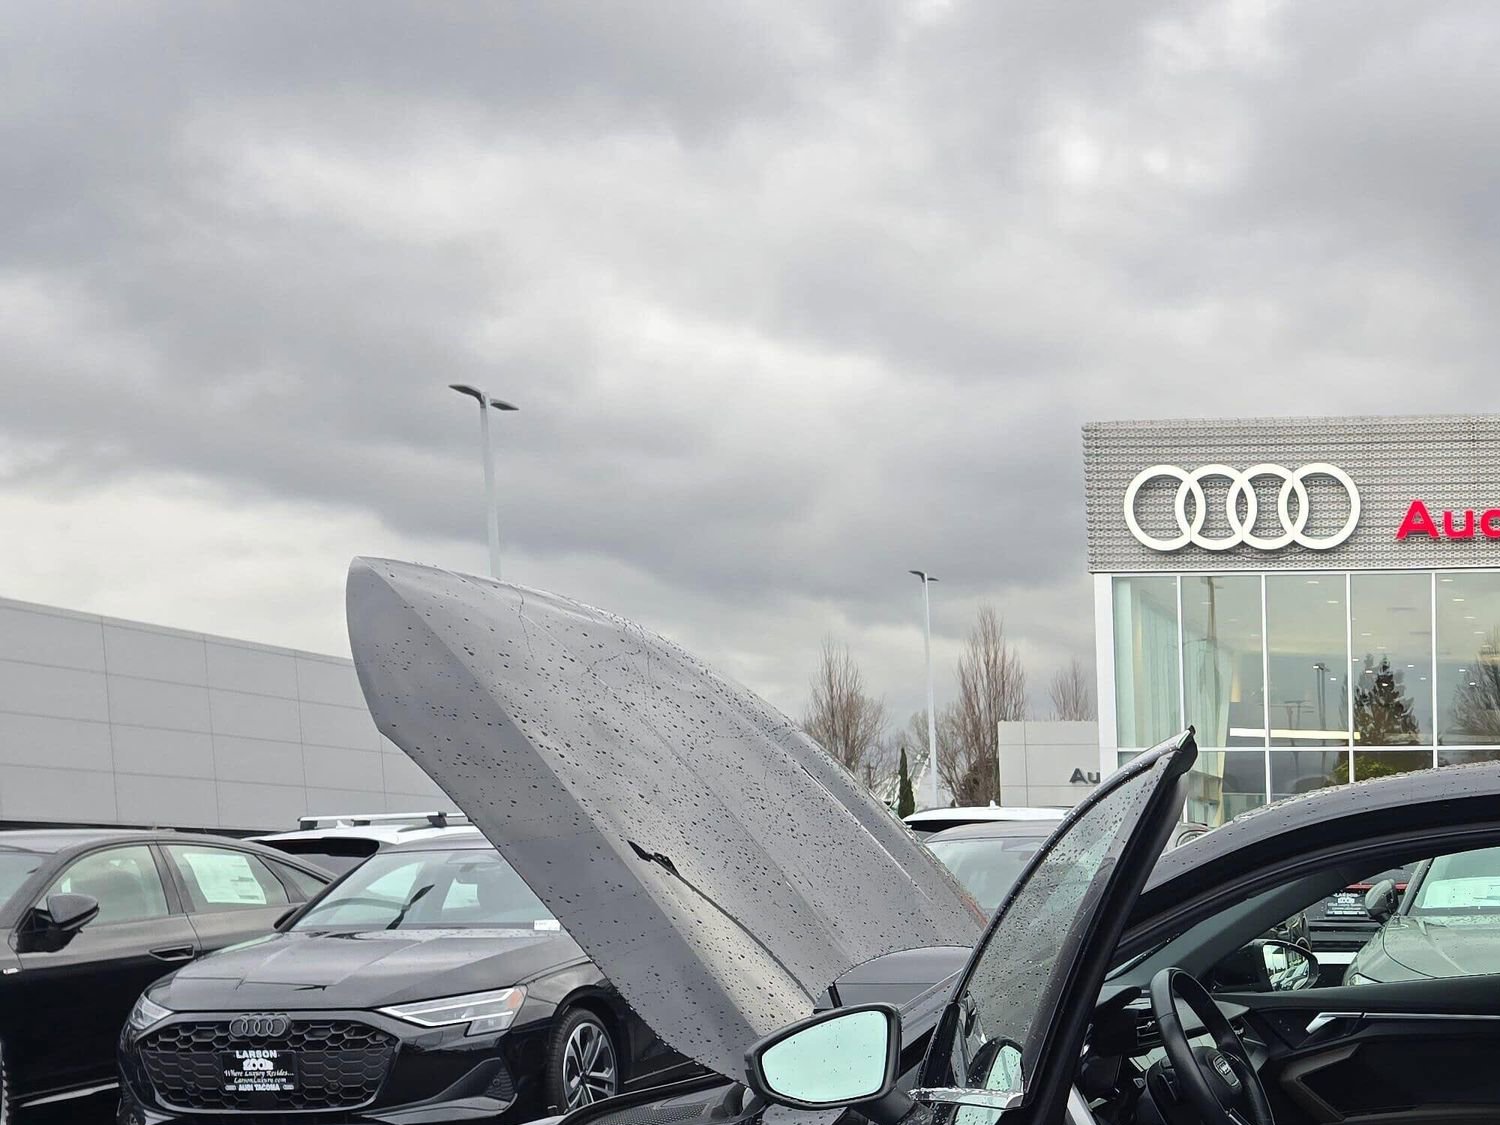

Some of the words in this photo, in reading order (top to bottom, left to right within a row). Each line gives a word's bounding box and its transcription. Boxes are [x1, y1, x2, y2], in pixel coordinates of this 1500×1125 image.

[235, 1049, 278, 1058] LARSON
[239, 1083, 254, 1091] AUDI
[254, 1083, 280, 1091] TACOMA
